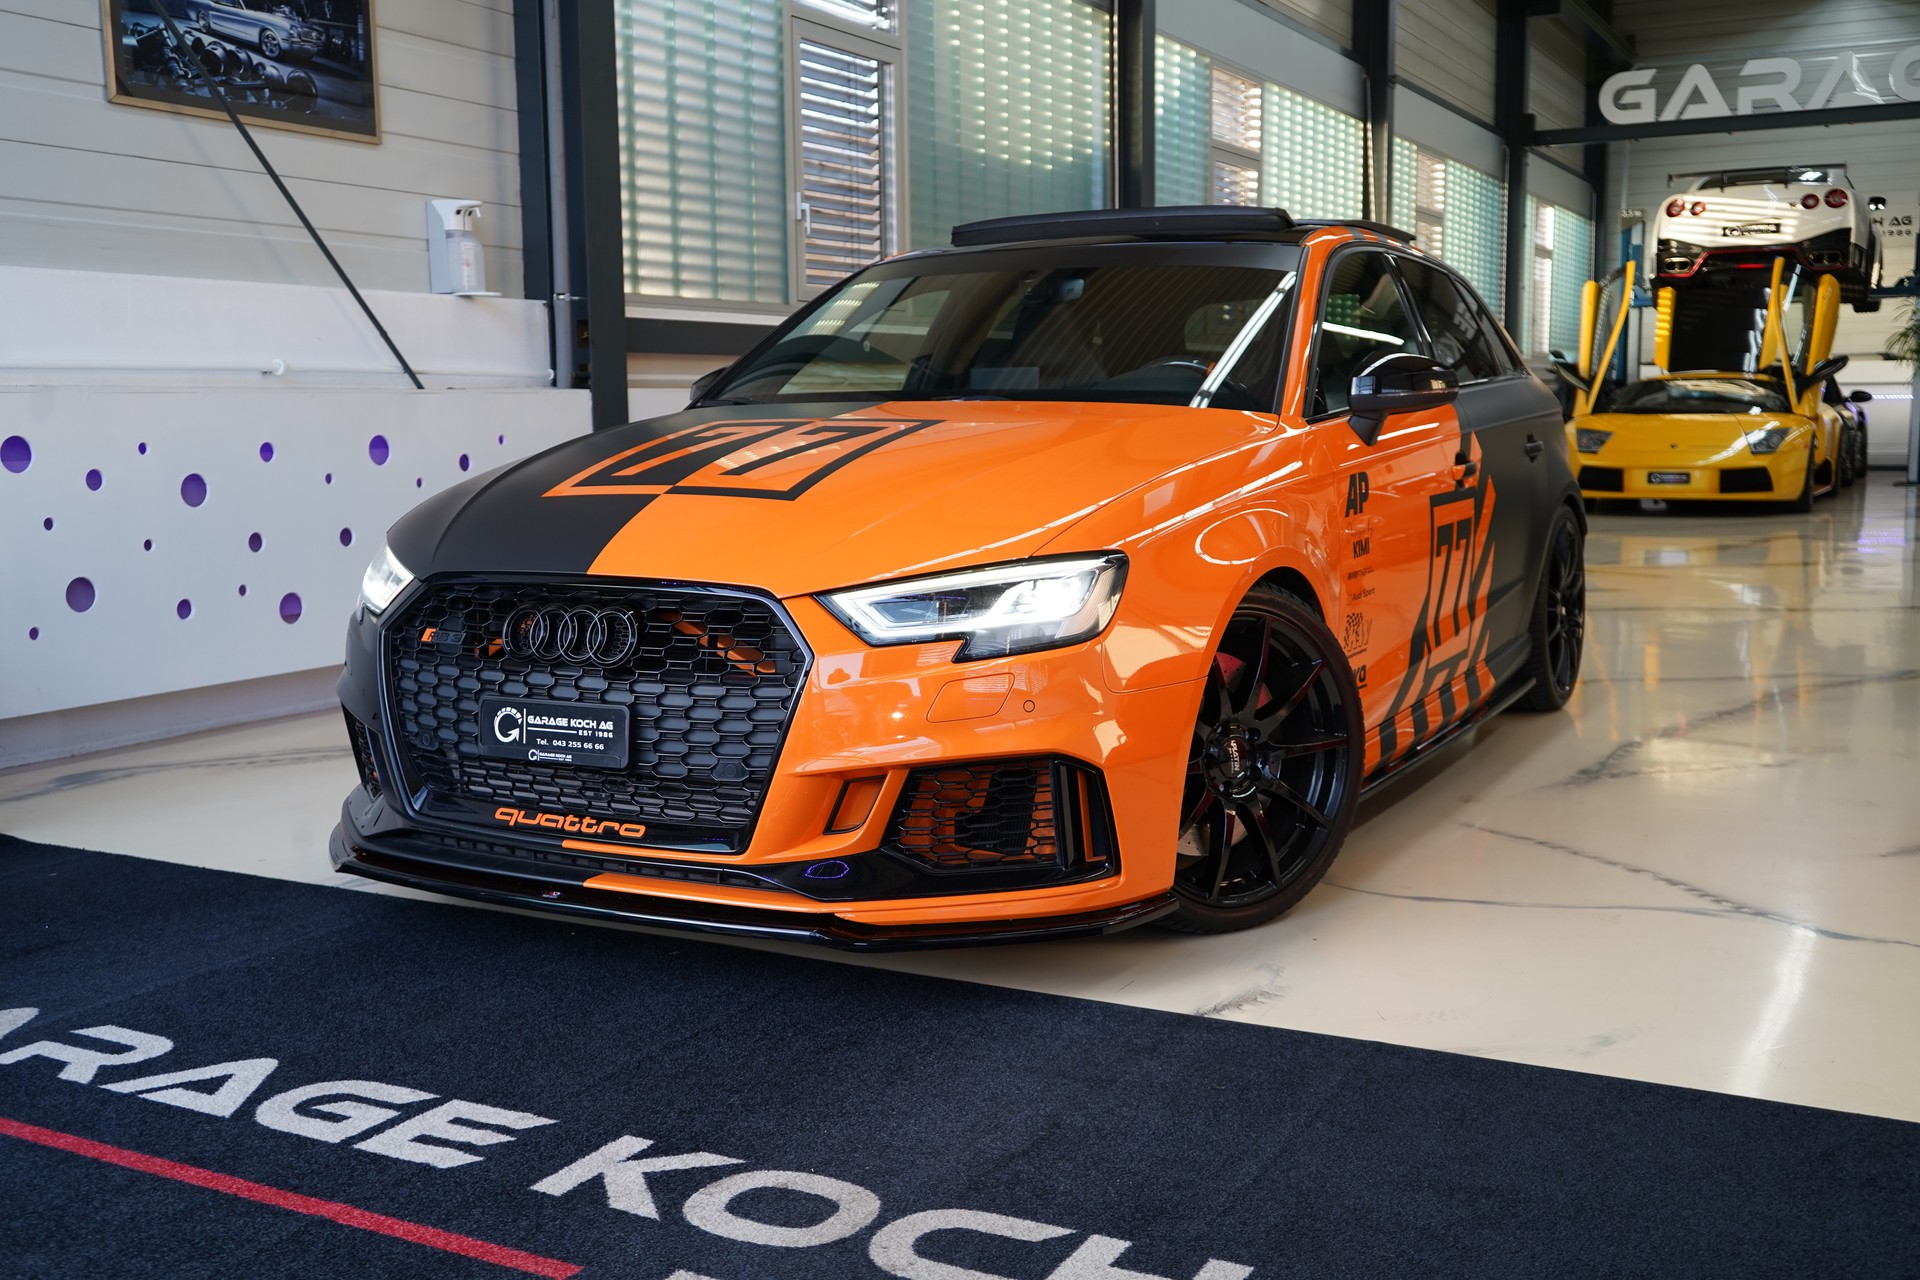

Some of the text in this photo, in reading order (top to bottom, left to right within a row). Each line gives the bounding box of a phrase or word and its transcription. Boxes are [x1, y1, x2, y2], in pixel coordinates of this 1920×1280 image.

[1889, 215, 1912, 226] AG
[1345, 471, 1369, 517] AP
[1353, 537, 1370, 559] KIMI
[1436, 516, 1474, 648] 77
[527, 715, 613, 730] GARAGE KOCH AG
[578, 729, 592, 737] EST
[536, 738, 549, 746] Tel.
[552, 739, 566, 747] 043
[568, 740, 582, 748] 255
[594, 742, 604, 750] 66
[494, 807, 646, 838] quattro
[0, 1007, 558, 1168] RAGE
